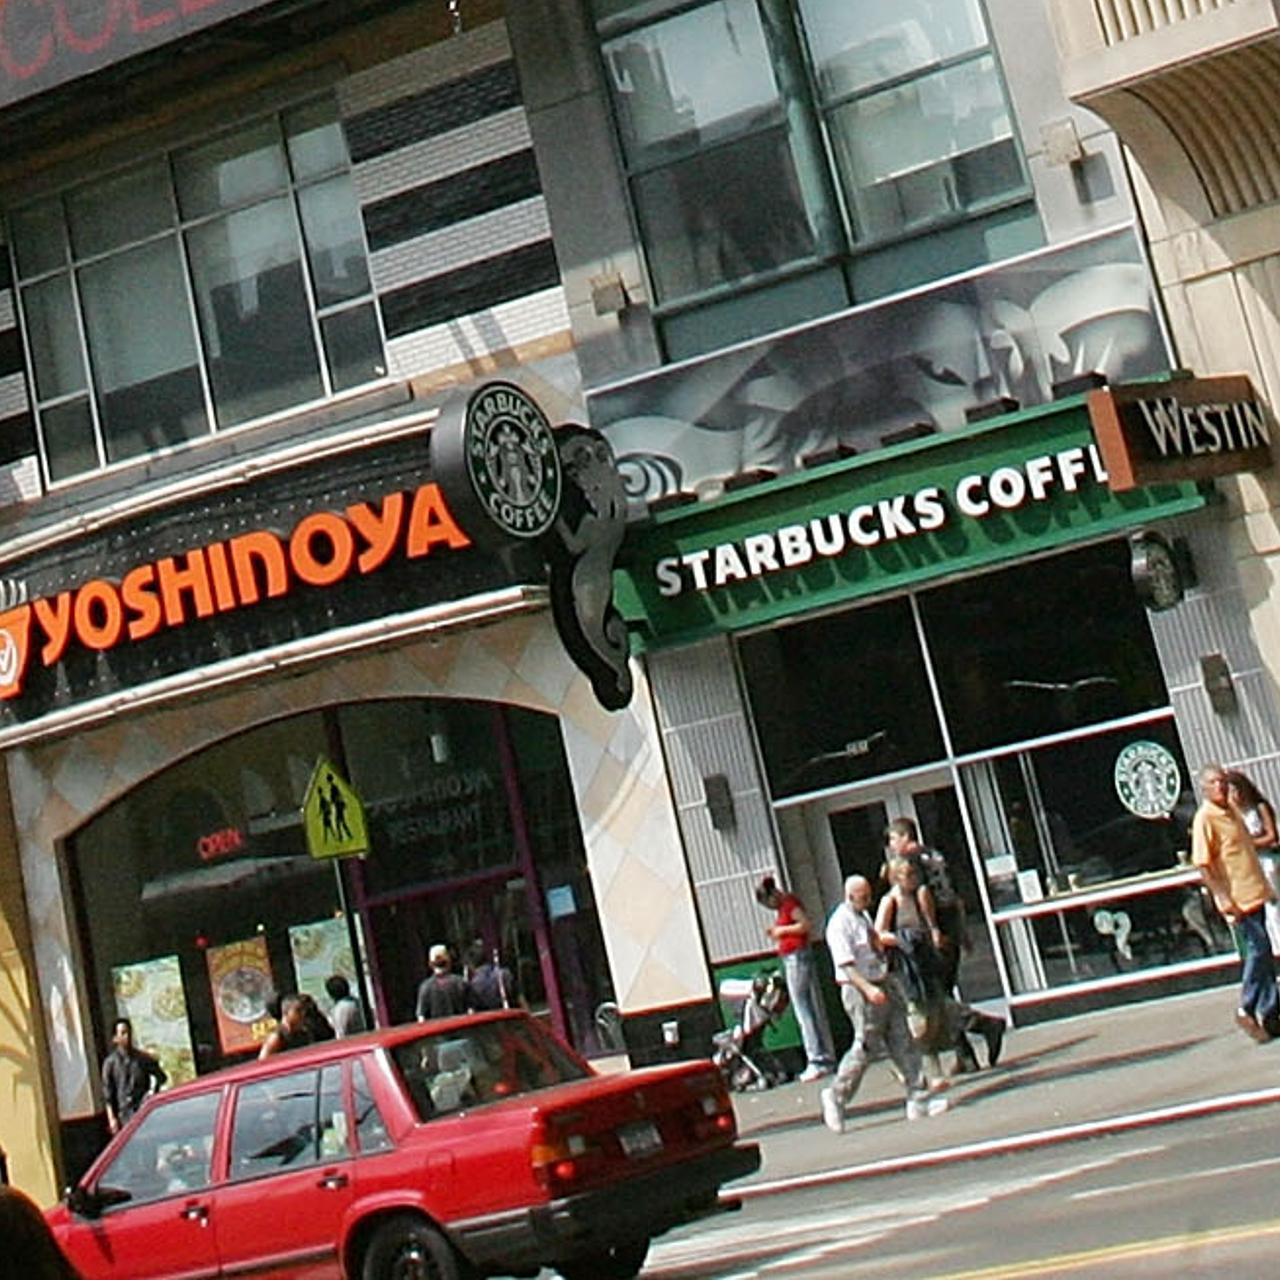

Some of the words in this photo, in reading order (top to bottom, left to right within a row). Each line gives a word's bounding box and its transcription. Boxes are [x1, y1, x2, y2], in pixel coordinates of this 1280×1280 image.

[471, 392, 549, 457] STARBUCKS
[489, 487, 553, 529] COFFEE
[655, 485, 947, 599] STARBUCKS
[954, 442, 1108, 518] COFF
